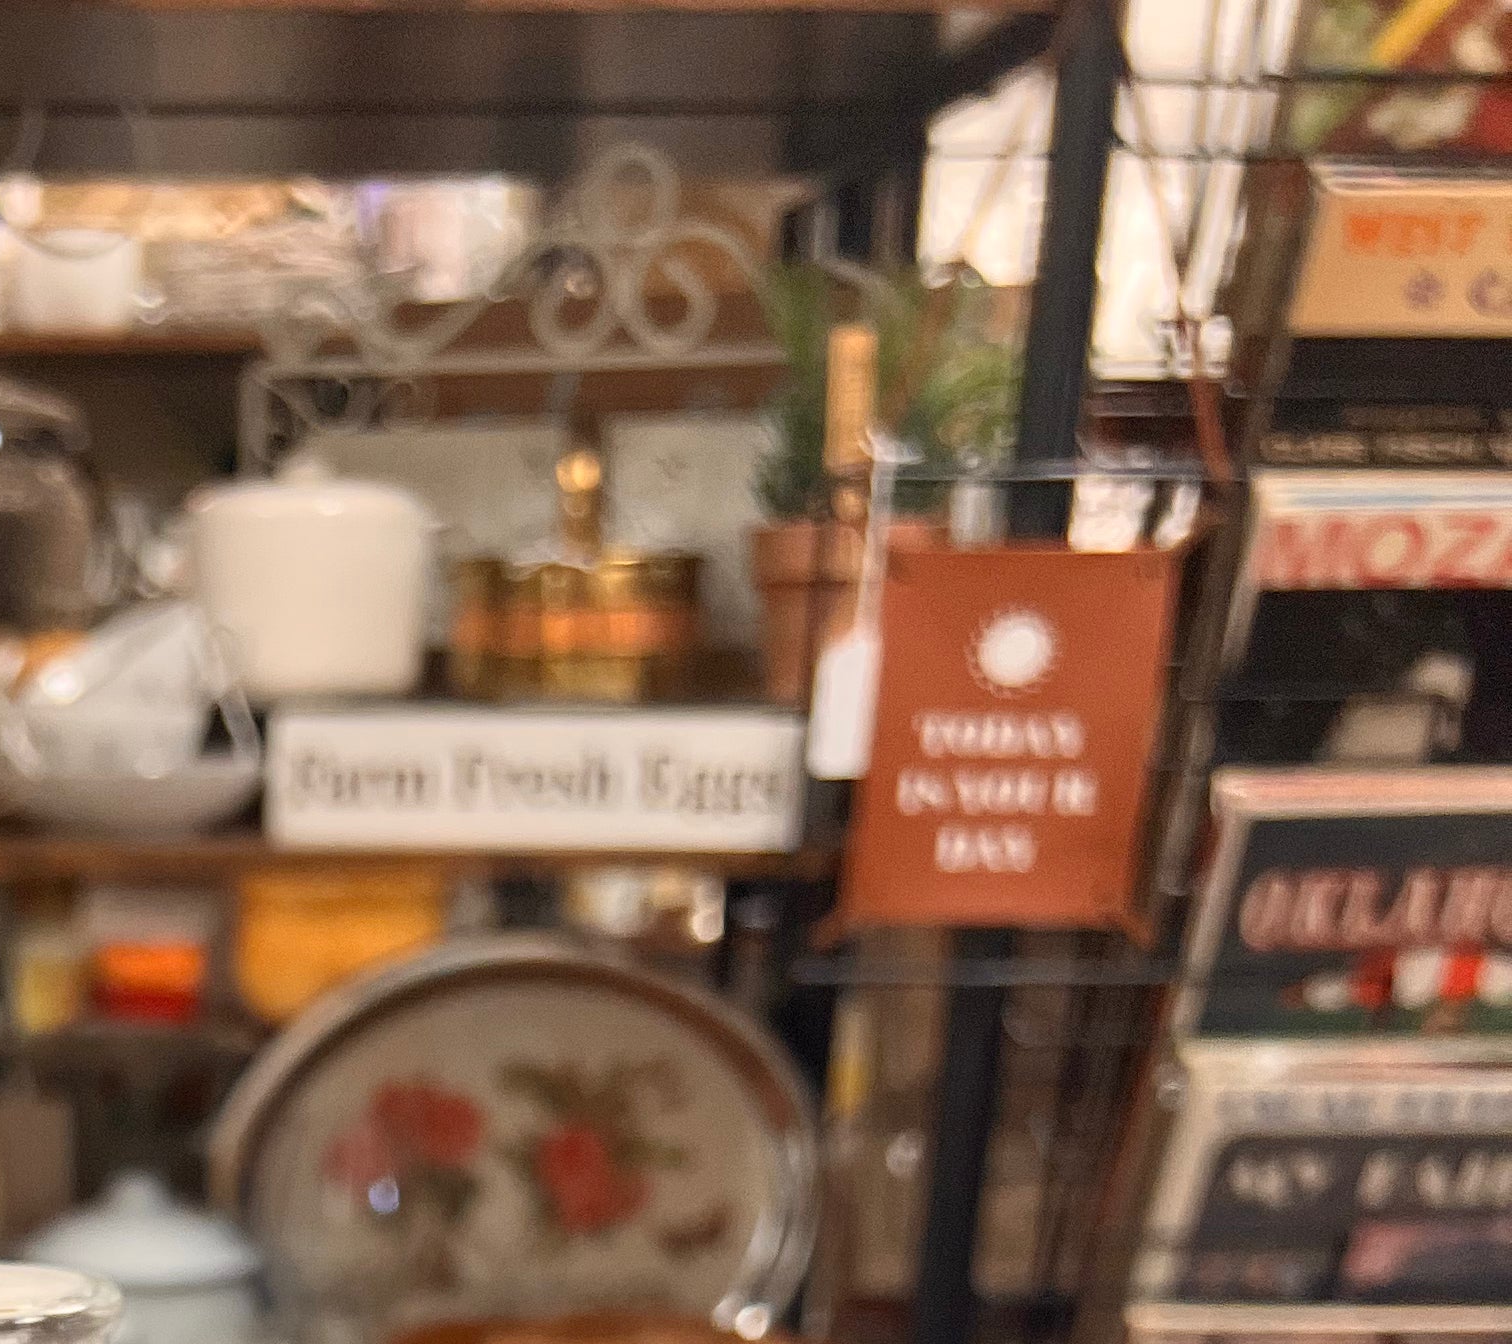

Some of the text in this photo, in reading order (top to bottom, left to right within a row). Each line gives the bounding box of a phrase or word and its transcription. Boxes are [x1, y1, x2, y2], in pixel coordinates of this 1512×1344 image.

[1256, 514, 1512, 589] MOZ
[912, 709, 1087, 759] TODAY
[934, 823, 1037, 873] DAY
